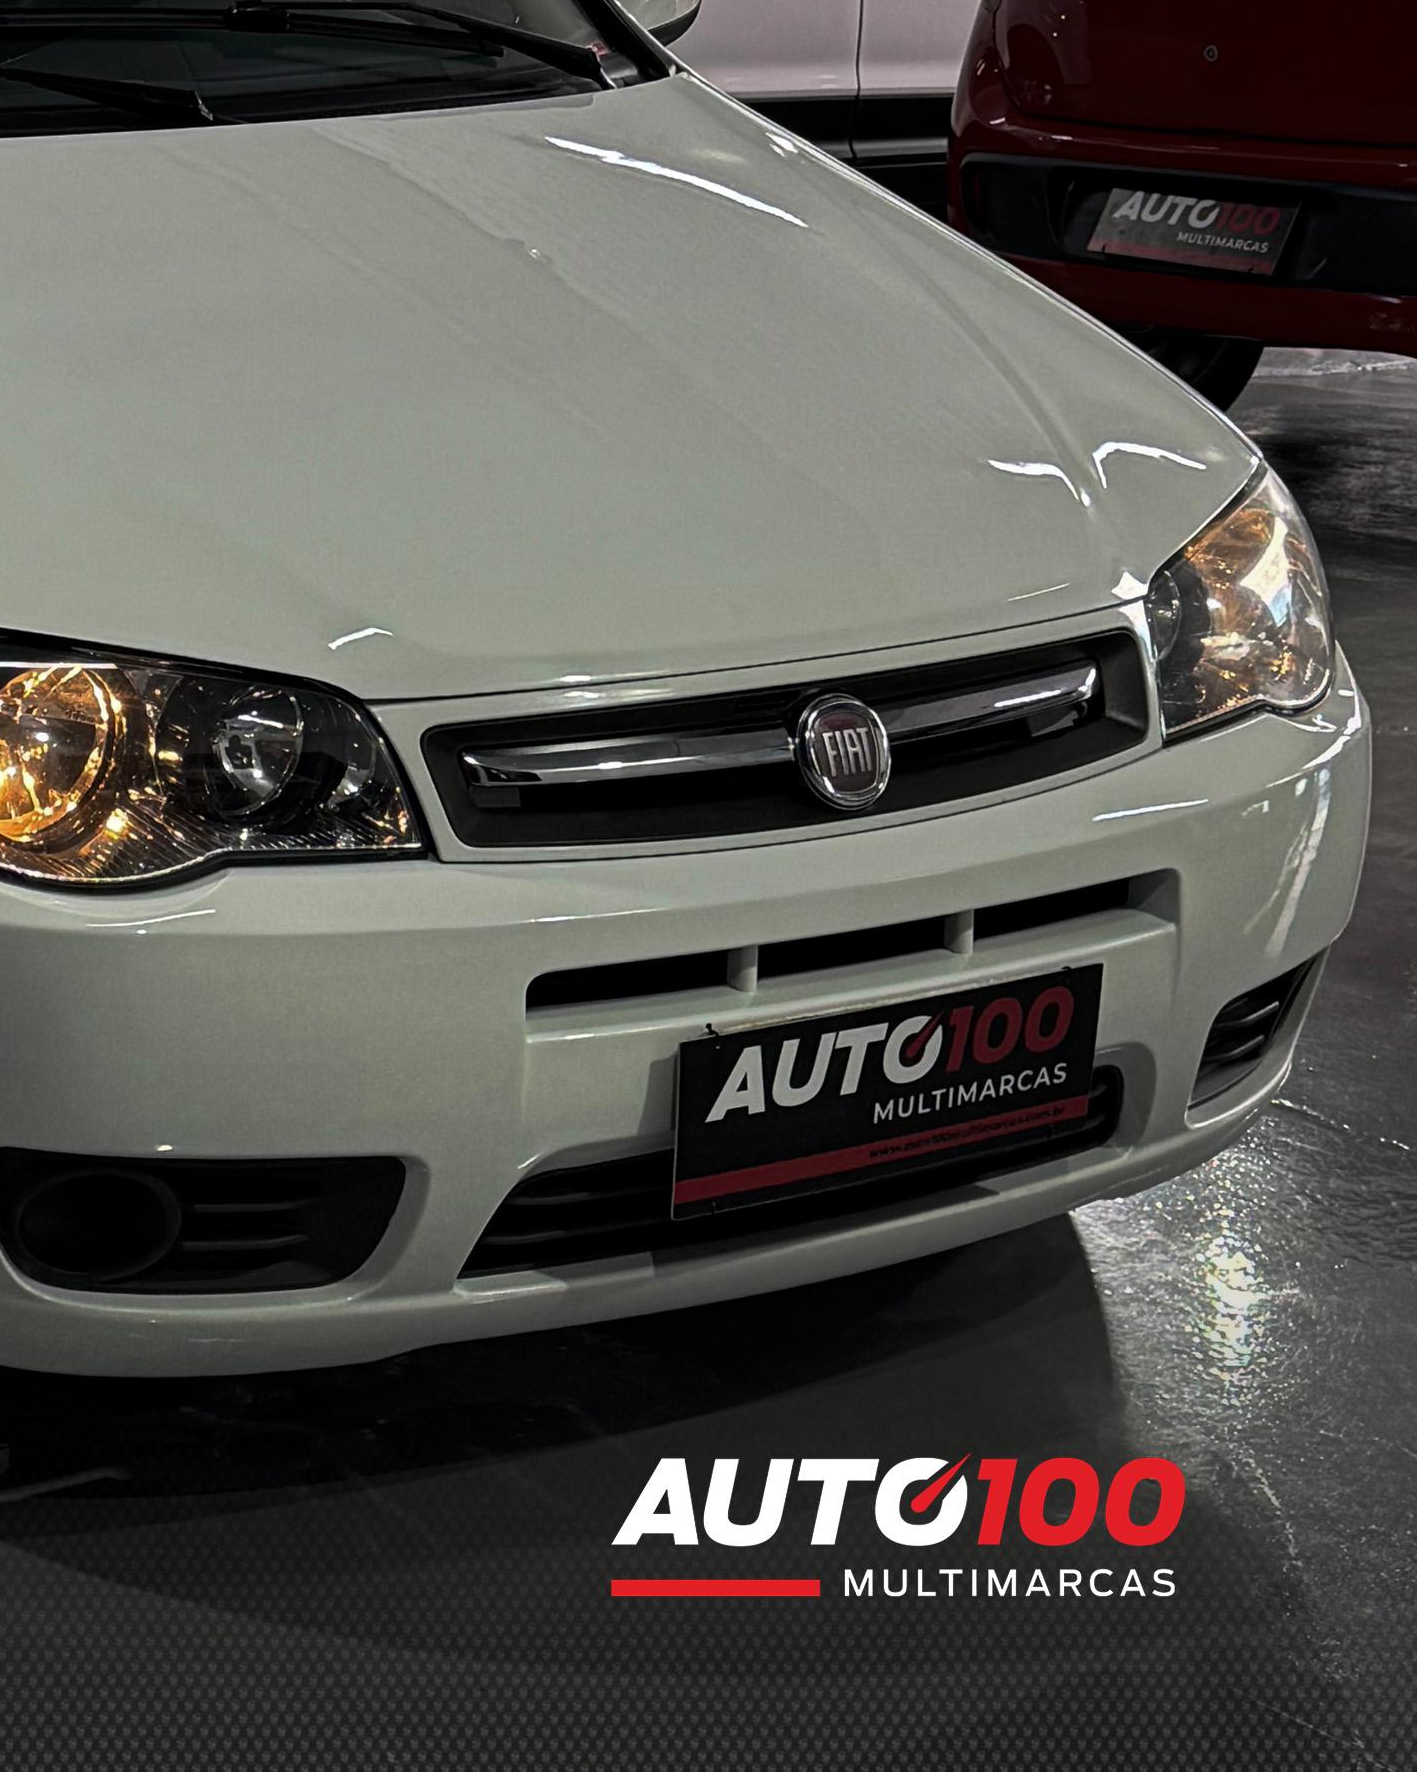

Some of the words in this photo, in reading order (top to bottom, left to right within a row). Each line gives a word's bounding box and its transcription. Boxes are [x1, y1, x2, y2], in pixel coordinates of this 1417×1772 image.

[1112, 190, 1280, 232] AUTO100
[1176, 230, 1269, 254] MULTIMARCAS
[821, 726, 873, 777] FIAT
[704, 986, 1075, 1123] AUTO100
[873, 1062, 1068, 1125] MULTIMARCAS
